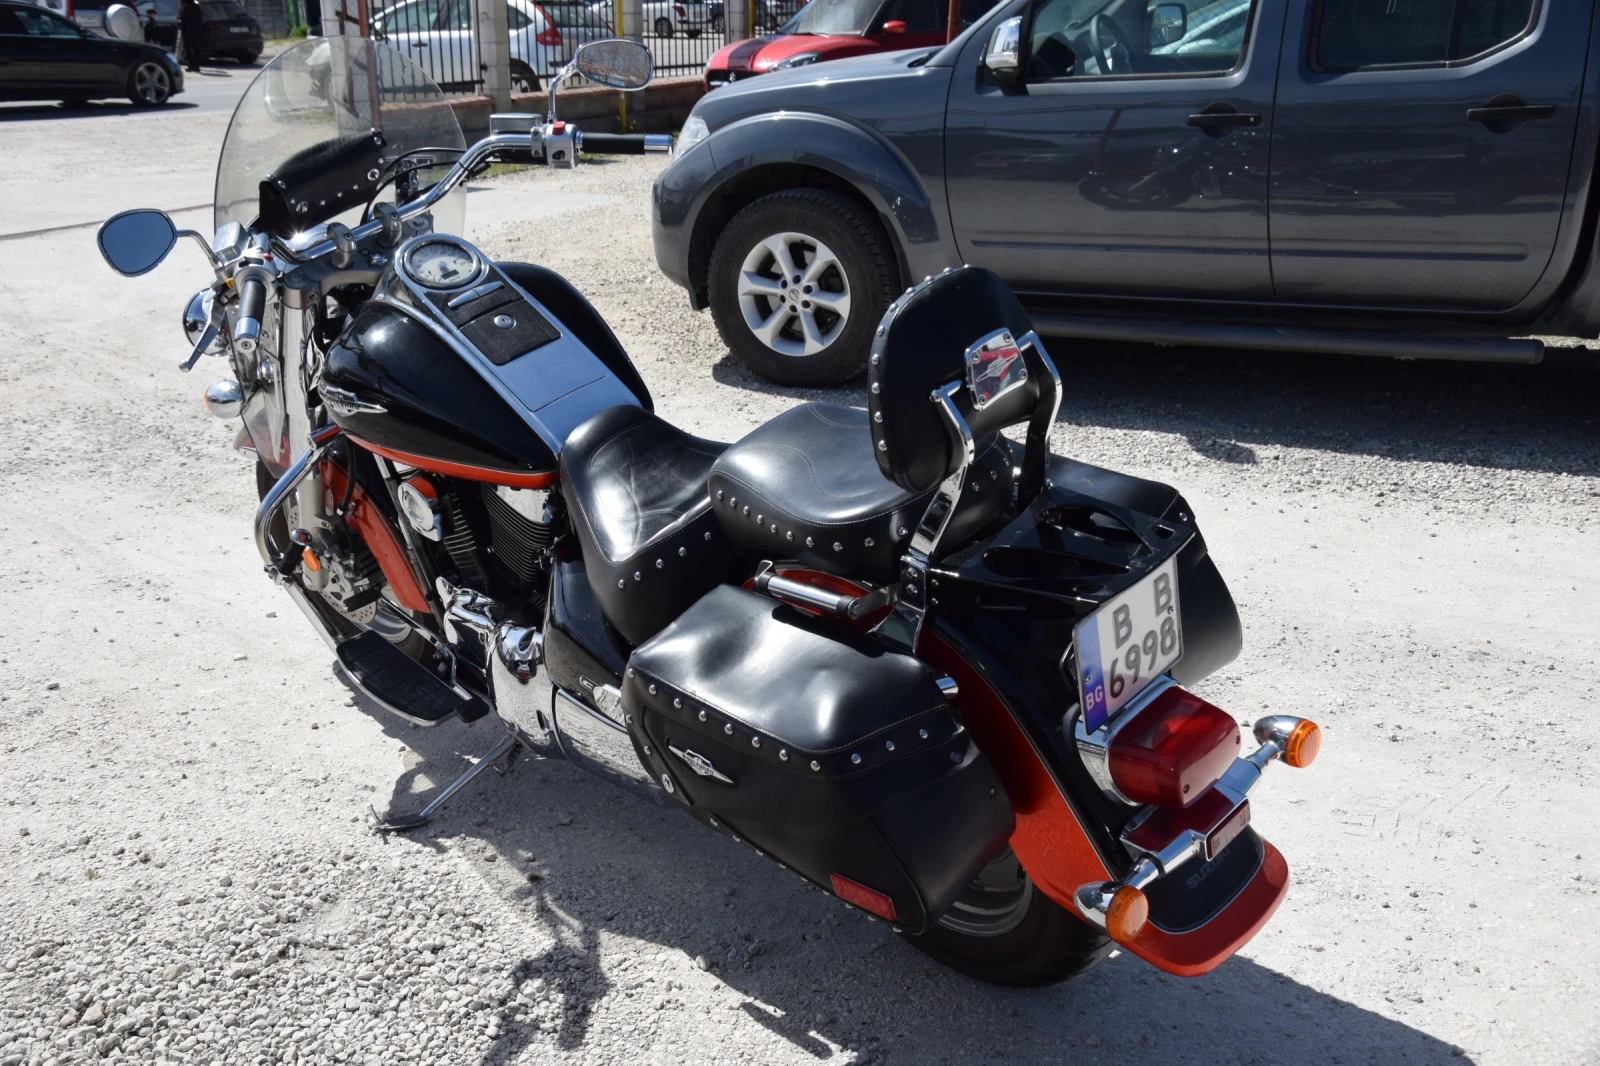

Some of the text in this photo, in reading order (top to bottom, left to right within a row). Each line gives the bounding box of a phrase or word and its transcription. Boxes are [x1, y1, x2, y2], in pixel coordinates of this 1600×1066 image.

[1113, 572, 1173, 650] B B
[1109, 616, 1176, 699] 6998
[1085, 686, 1103, 711] BG
